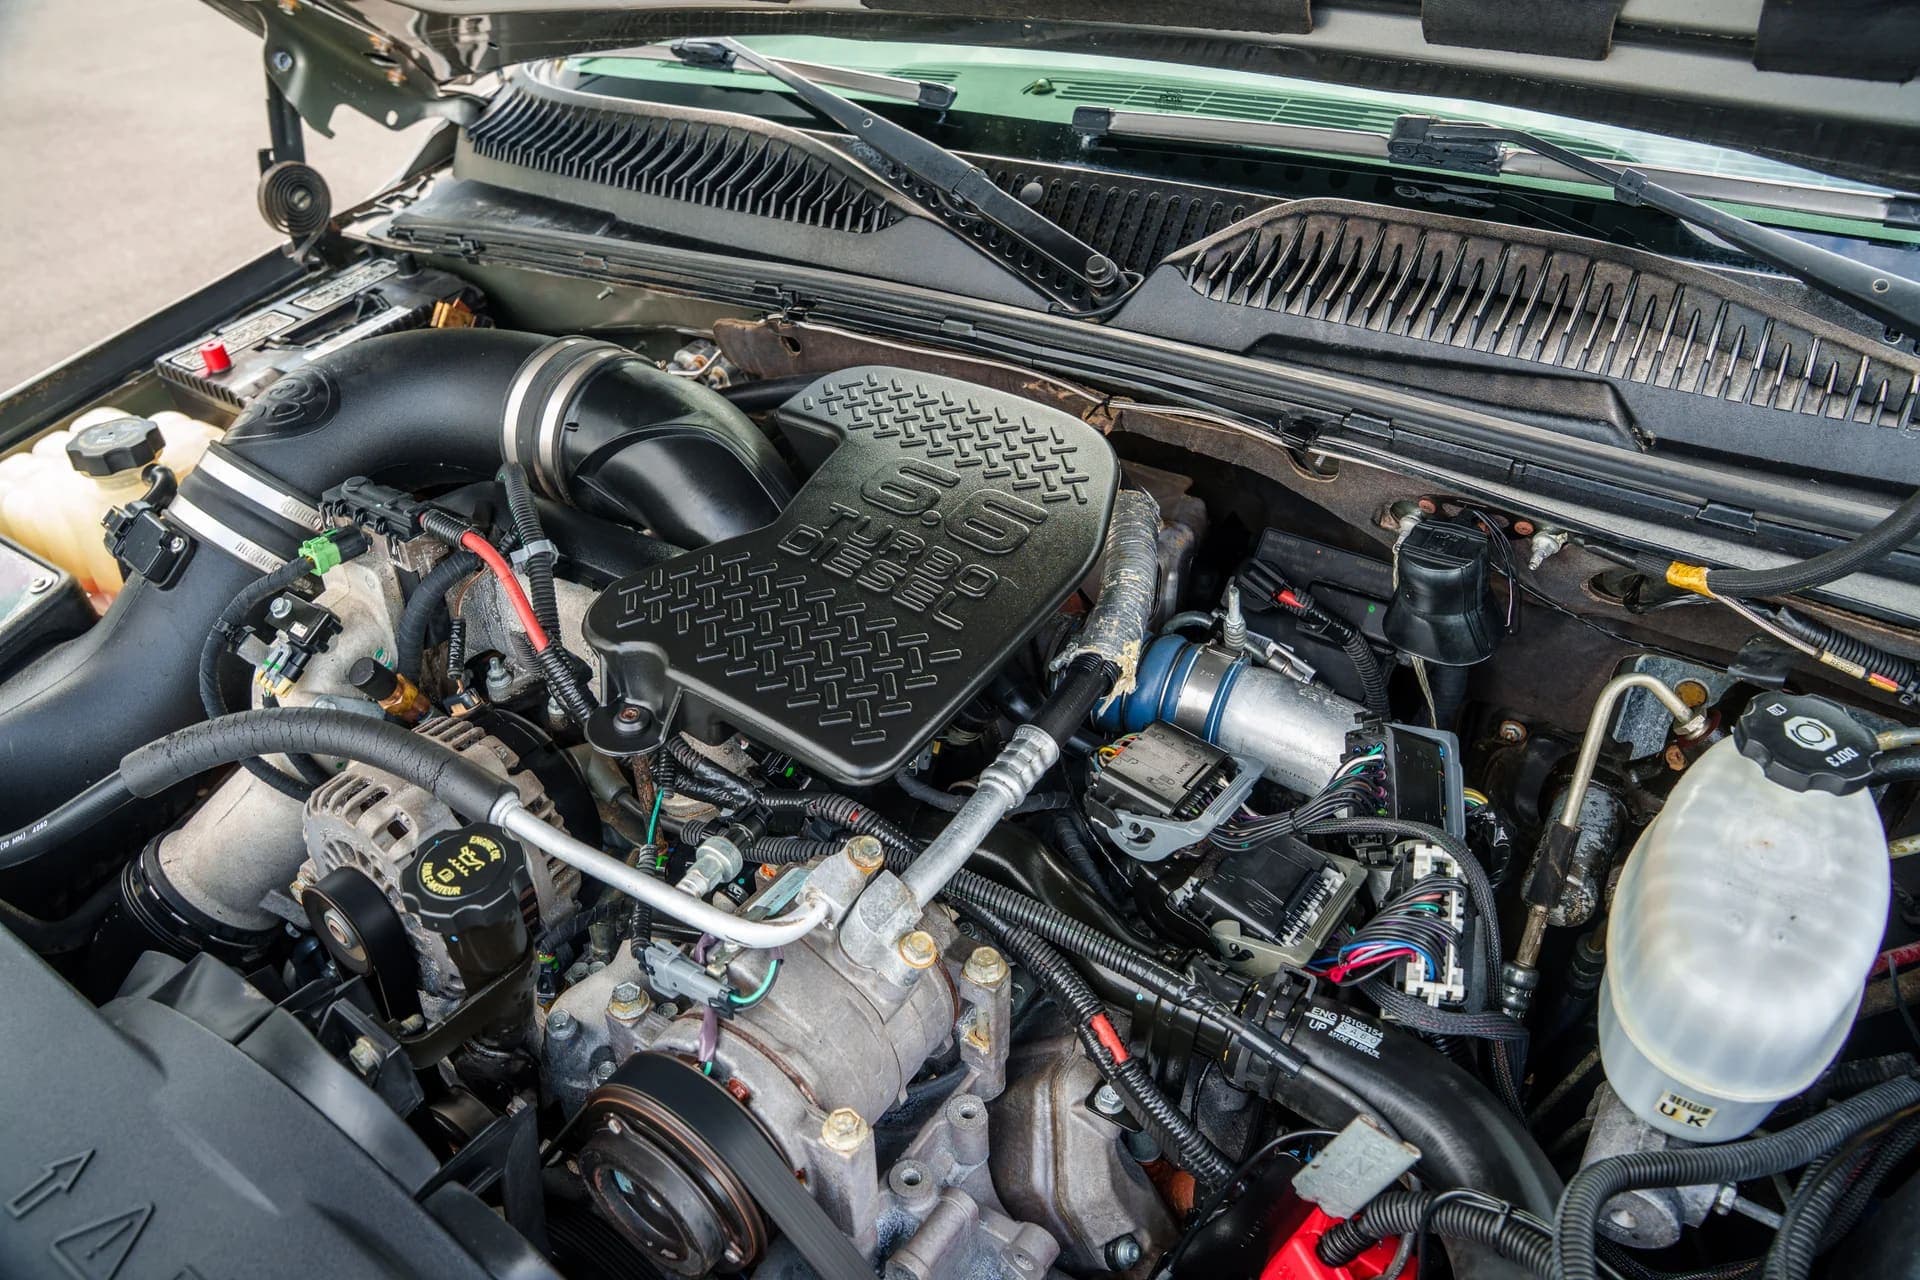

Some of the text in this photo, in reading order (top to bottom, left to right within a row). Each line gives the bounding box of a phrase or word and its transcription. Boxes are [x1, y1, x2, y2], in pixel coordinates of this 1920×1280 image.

[861, 457, 1048, 555] 6.6
[822, 501, 999, 598] TURBO
[777, 523, 965, 631] DIESEL
[1824, 746, 1859, 768] DOT3
[469, 835, 497, 852] ENGINE
[1308, 1019, 1328, 1031] UP
[1311, 1006, 1384, 1037] ENG 15102154
[1327, 1030, 1348, 1044] MADE
